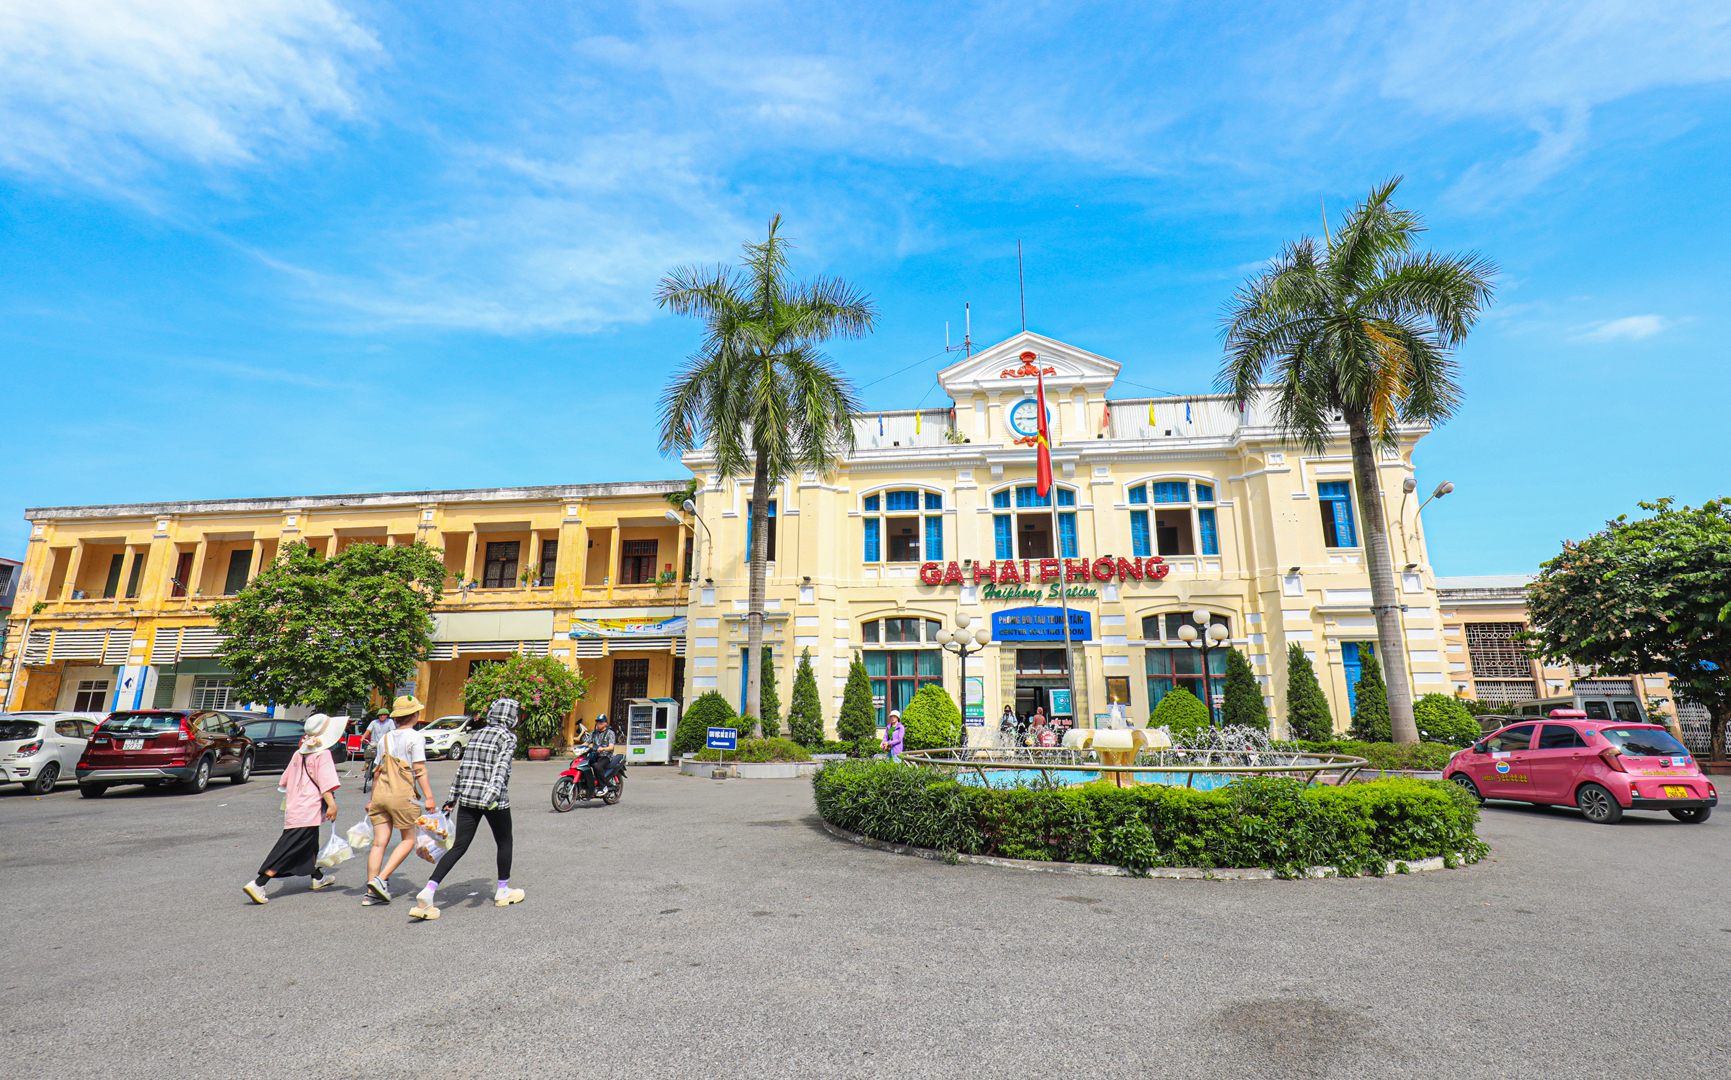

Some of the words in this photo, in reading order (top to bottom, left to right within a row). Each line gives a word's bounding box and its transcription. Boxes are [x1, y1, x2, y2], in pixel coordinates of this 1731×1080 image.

[920, 561, 965, 585] GA
[973, 559, 1031, 584] HAI
[1040, 556, 1170, 582] PHONG
[982, 583, 1043, 603] Haiphong
[1048, 583, 1097, 598] Sation
[998, 614, 1020, 625] PHÒNG
[1033, 614, 1046, 625] TÀU
[1047, 615, 1067, 624] TRUN
[1069, 613, 1084, 625] TÂM
